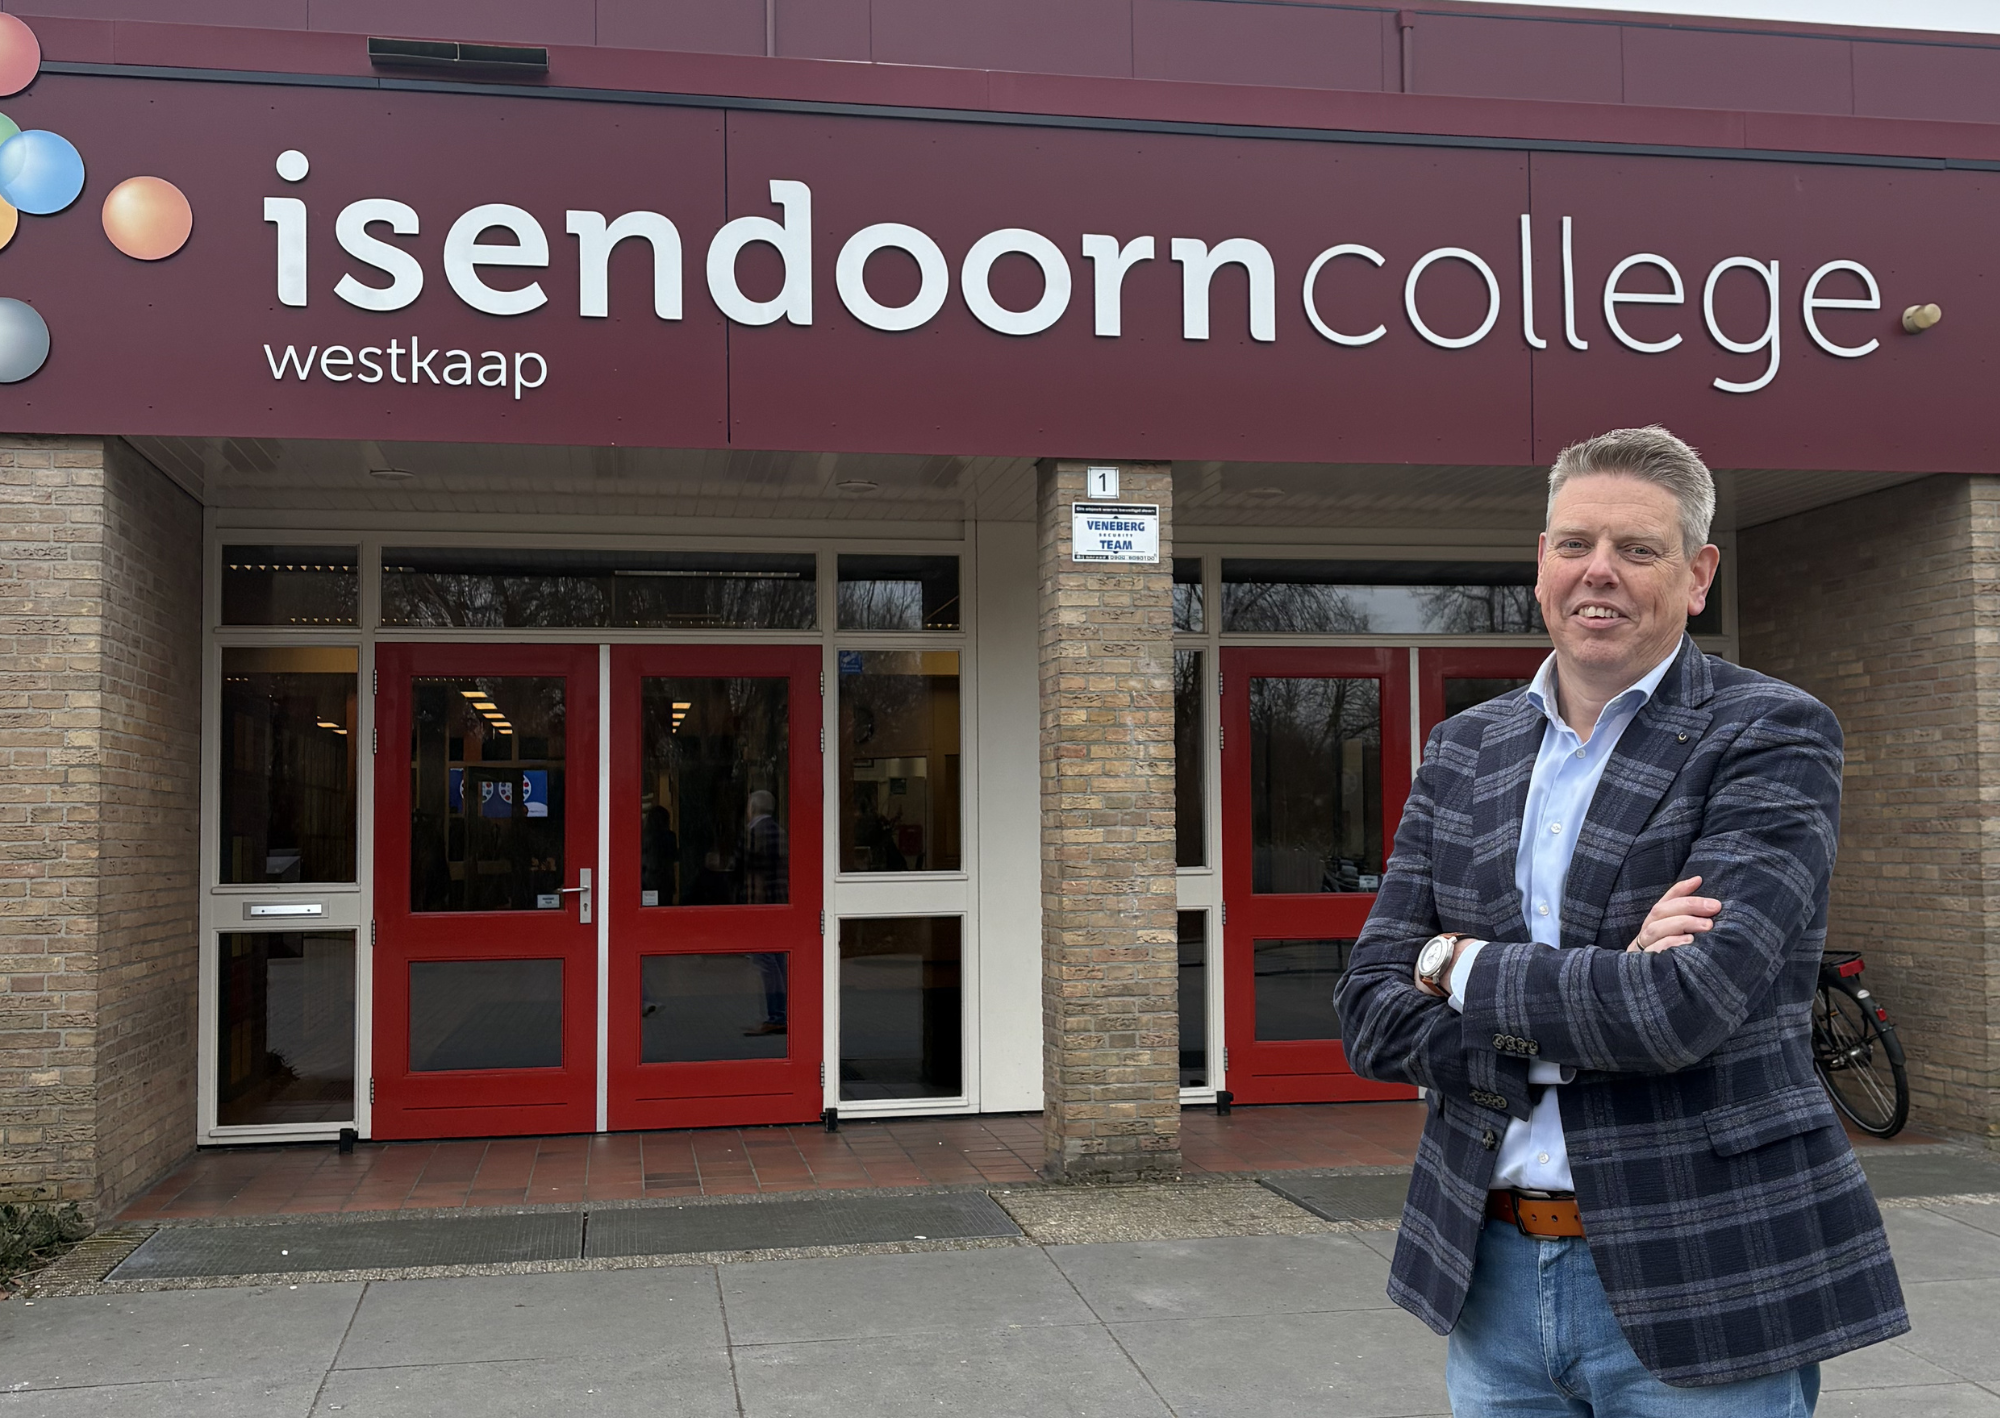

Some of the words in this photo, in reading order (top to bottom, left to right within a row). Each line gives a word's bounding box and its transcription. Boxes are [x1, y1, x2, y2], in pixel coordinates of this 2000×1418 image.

[263, 335, 548, 400] westkaap
[1098, 472, 1106, 492] 1
[1087, 520, 1145, 532] VENEBERG
[1099, 540, 1133, 550] TEAM
